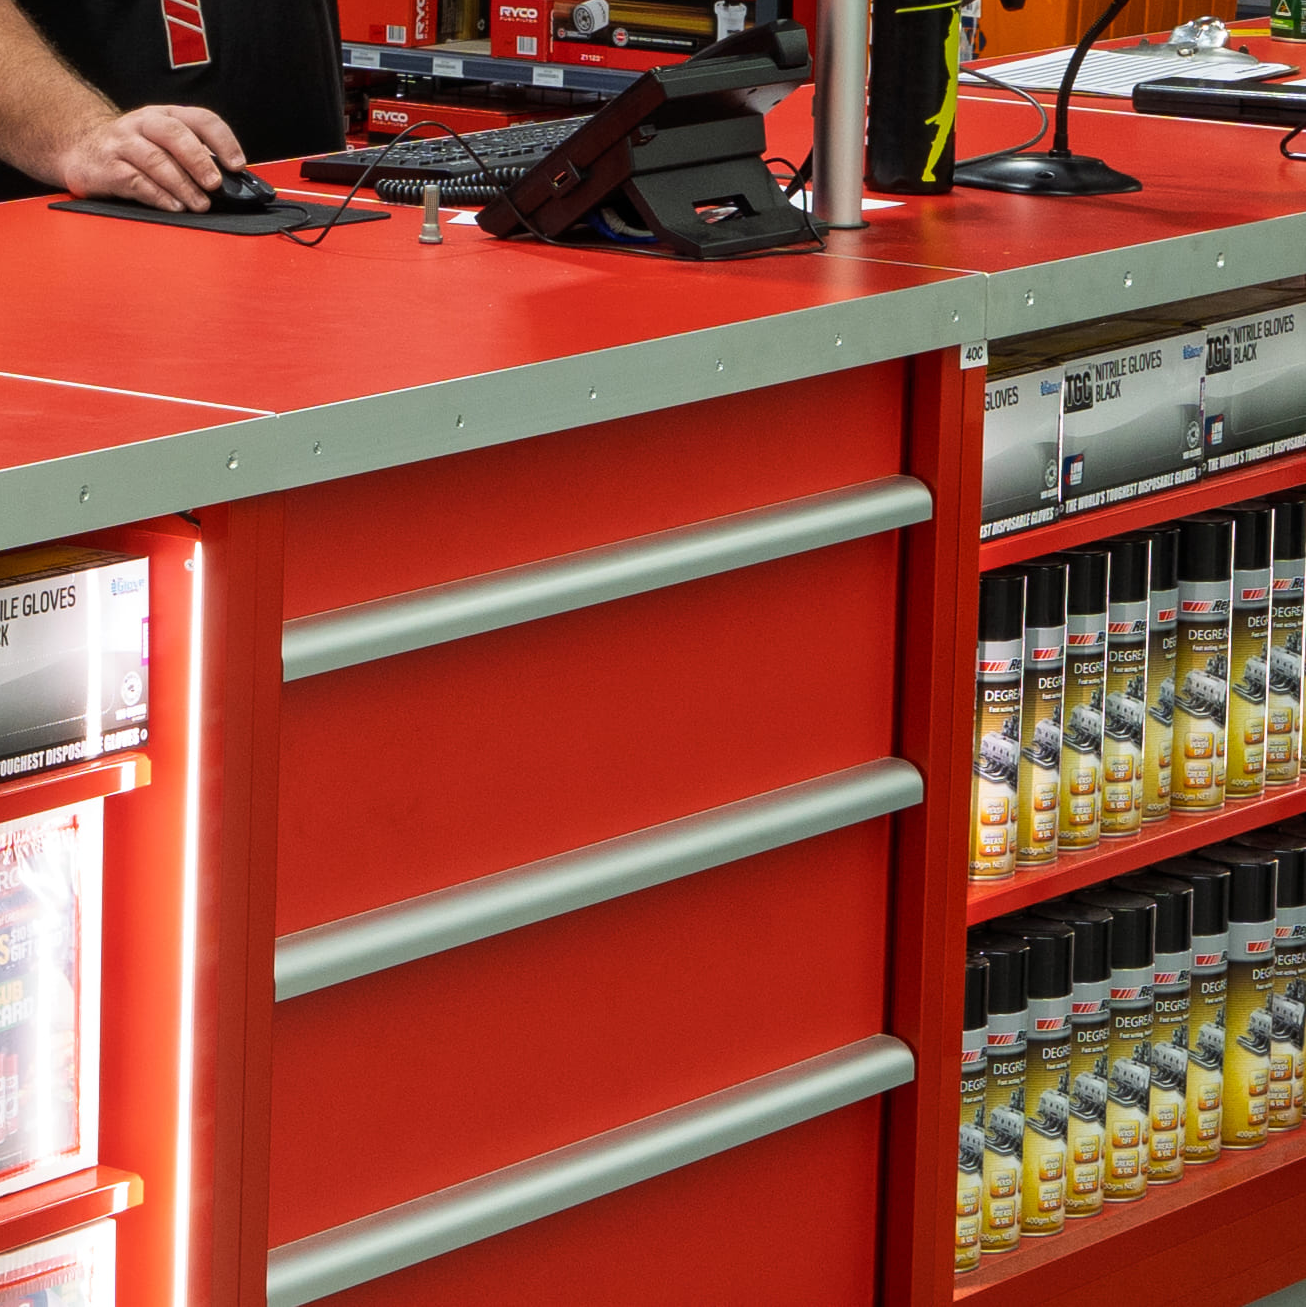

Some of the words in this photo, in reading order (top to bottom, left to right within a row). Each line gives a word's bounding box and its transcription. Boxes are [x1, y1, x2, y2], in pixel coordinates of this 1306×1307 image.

[965, 347, 983, 361] 40C
[1095, 357, 1127, 381] NITRILE
[1128, 350, 1162, 374] GLOVES
[1066, 371, 1092, 407] TGC
[1096, 379, 1121, 402] BLACK
[22, 585, 76, 617] GLOVES
[1188, 629, 1228, 642] DEGREA
